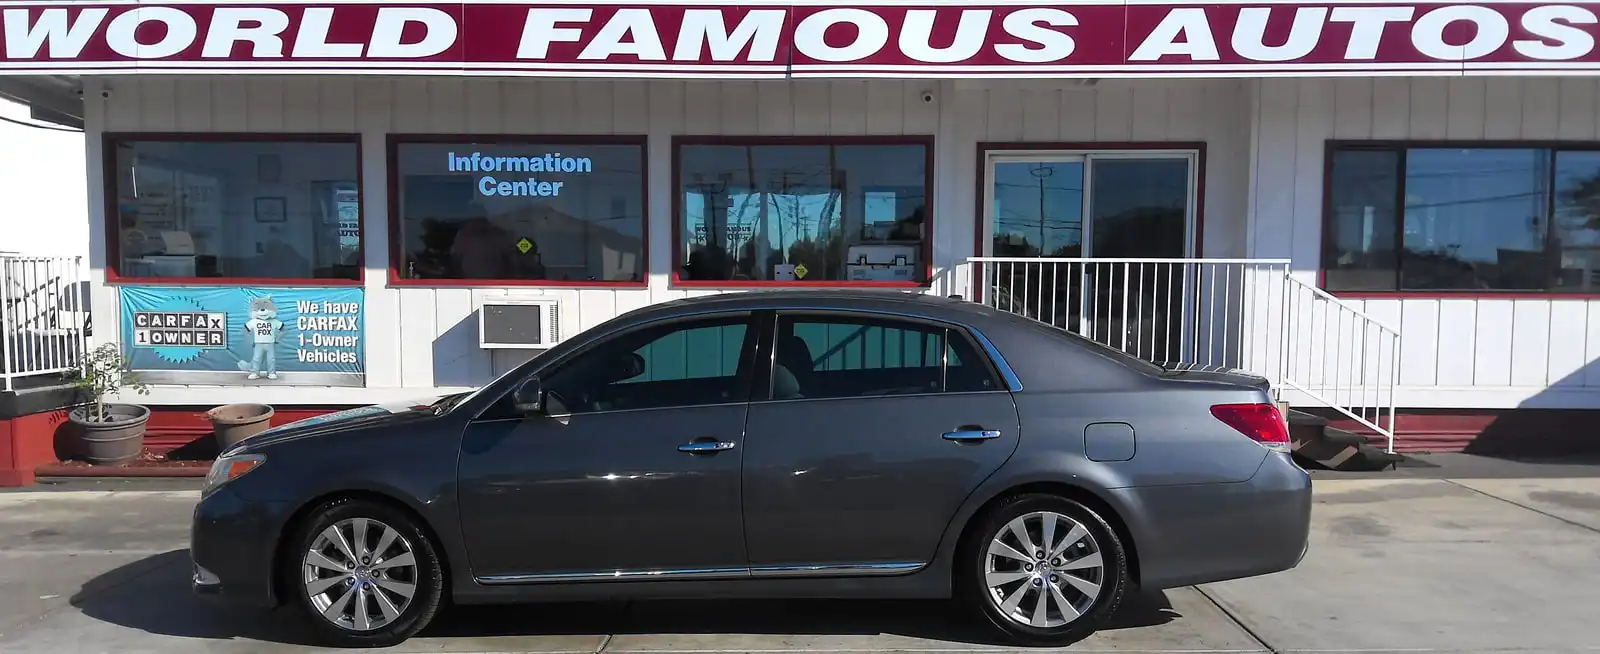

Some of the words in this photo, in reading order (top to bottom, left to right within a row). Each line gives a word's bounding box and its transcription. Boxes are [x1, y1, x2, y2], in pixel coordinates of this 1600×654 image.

[3, 6, 458, 60] WORLD
[516, 7, 1076, 63] FAMOUS
[1127, 4, 1597, 62] AUTOS
[448, 152, 591, 172] Information
[478, 176, 563, 196] Center
[297, 300, 320, 315] We
[323, 301, 359, 315] have
[135, 313, 222, 329] CARFAX
[297, 316, 358, 332] CARFAX
[138, 331, 148, 344] 1
[151, 332, 224, 345] OWNER
[257, 329, 273, 337] FOX
[298, 334, 358, 348] 1-Owner
[297, 350, 358, 365] Vehicles
